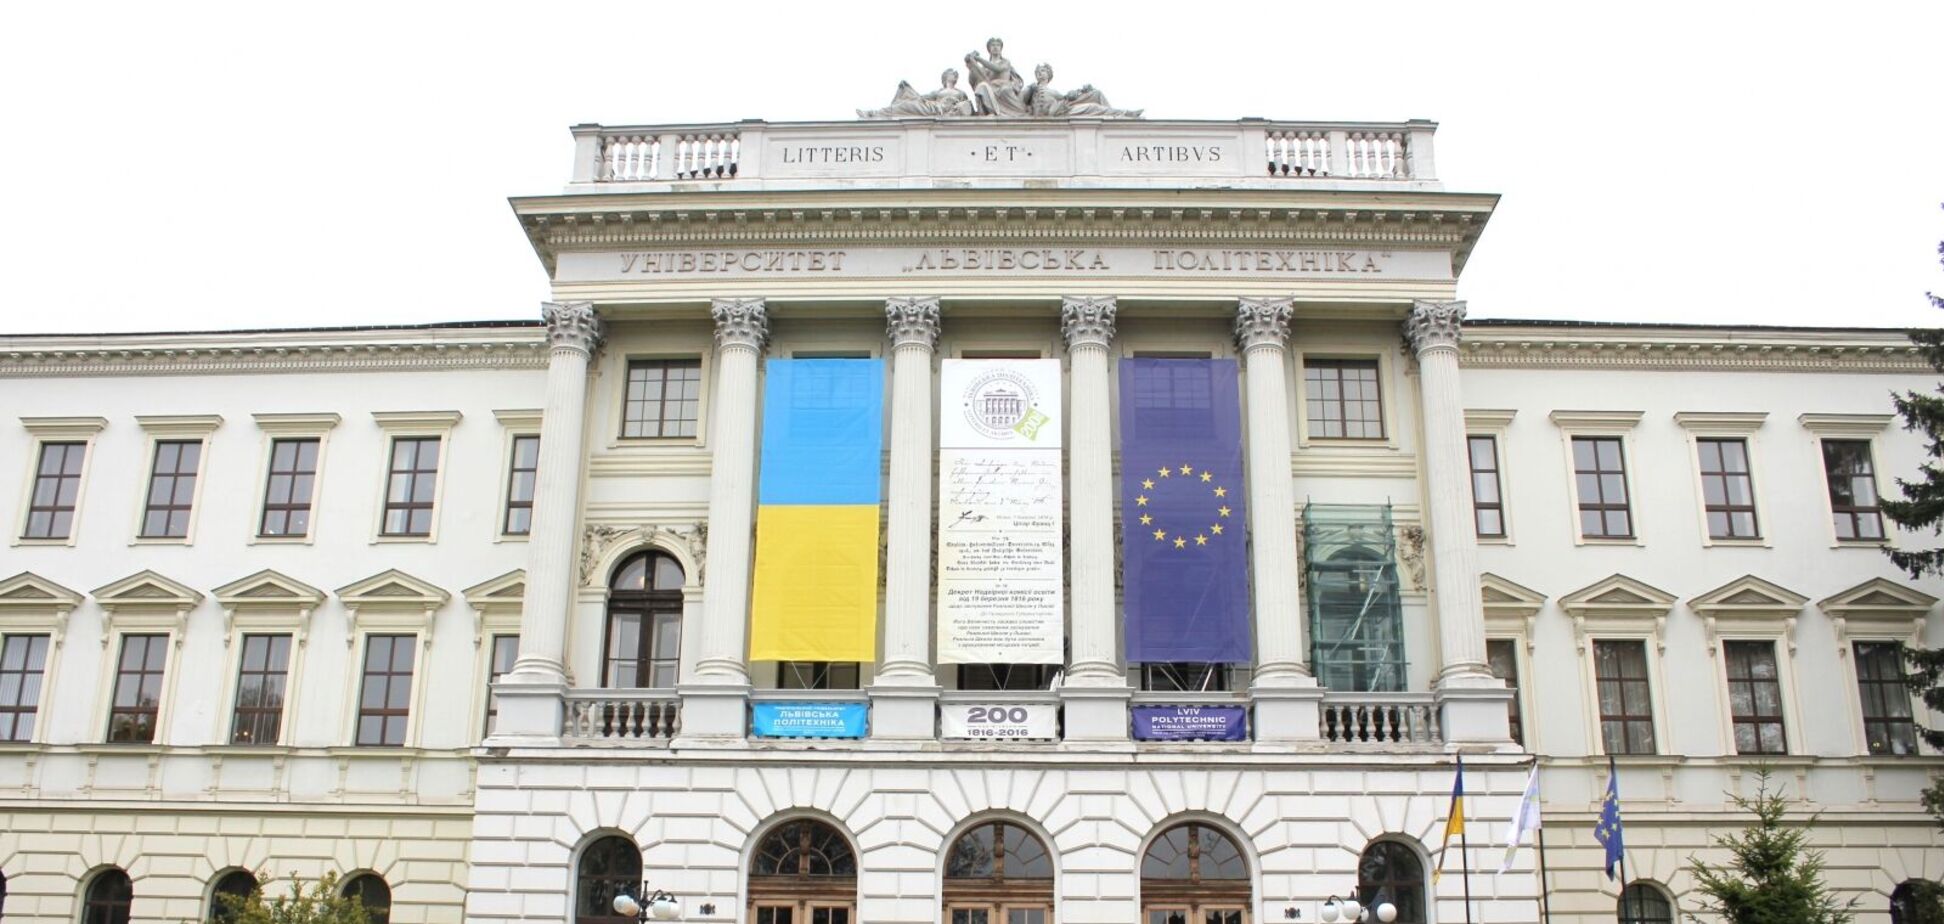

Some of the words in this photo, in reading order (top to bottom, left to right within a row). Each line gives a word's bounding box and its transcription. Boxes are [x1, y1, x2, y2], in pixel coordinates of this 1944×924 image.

[783, 146, 885, 164] LITTERIS
[1120, 145, 1222, 163] ARTIBVS
[620, 251, 848, 273] УНІВЕРСИТЕТ
[780, 710, 839, 718] ЛЬВІВСЬКА
[967, 707, 1028, 723] 200
